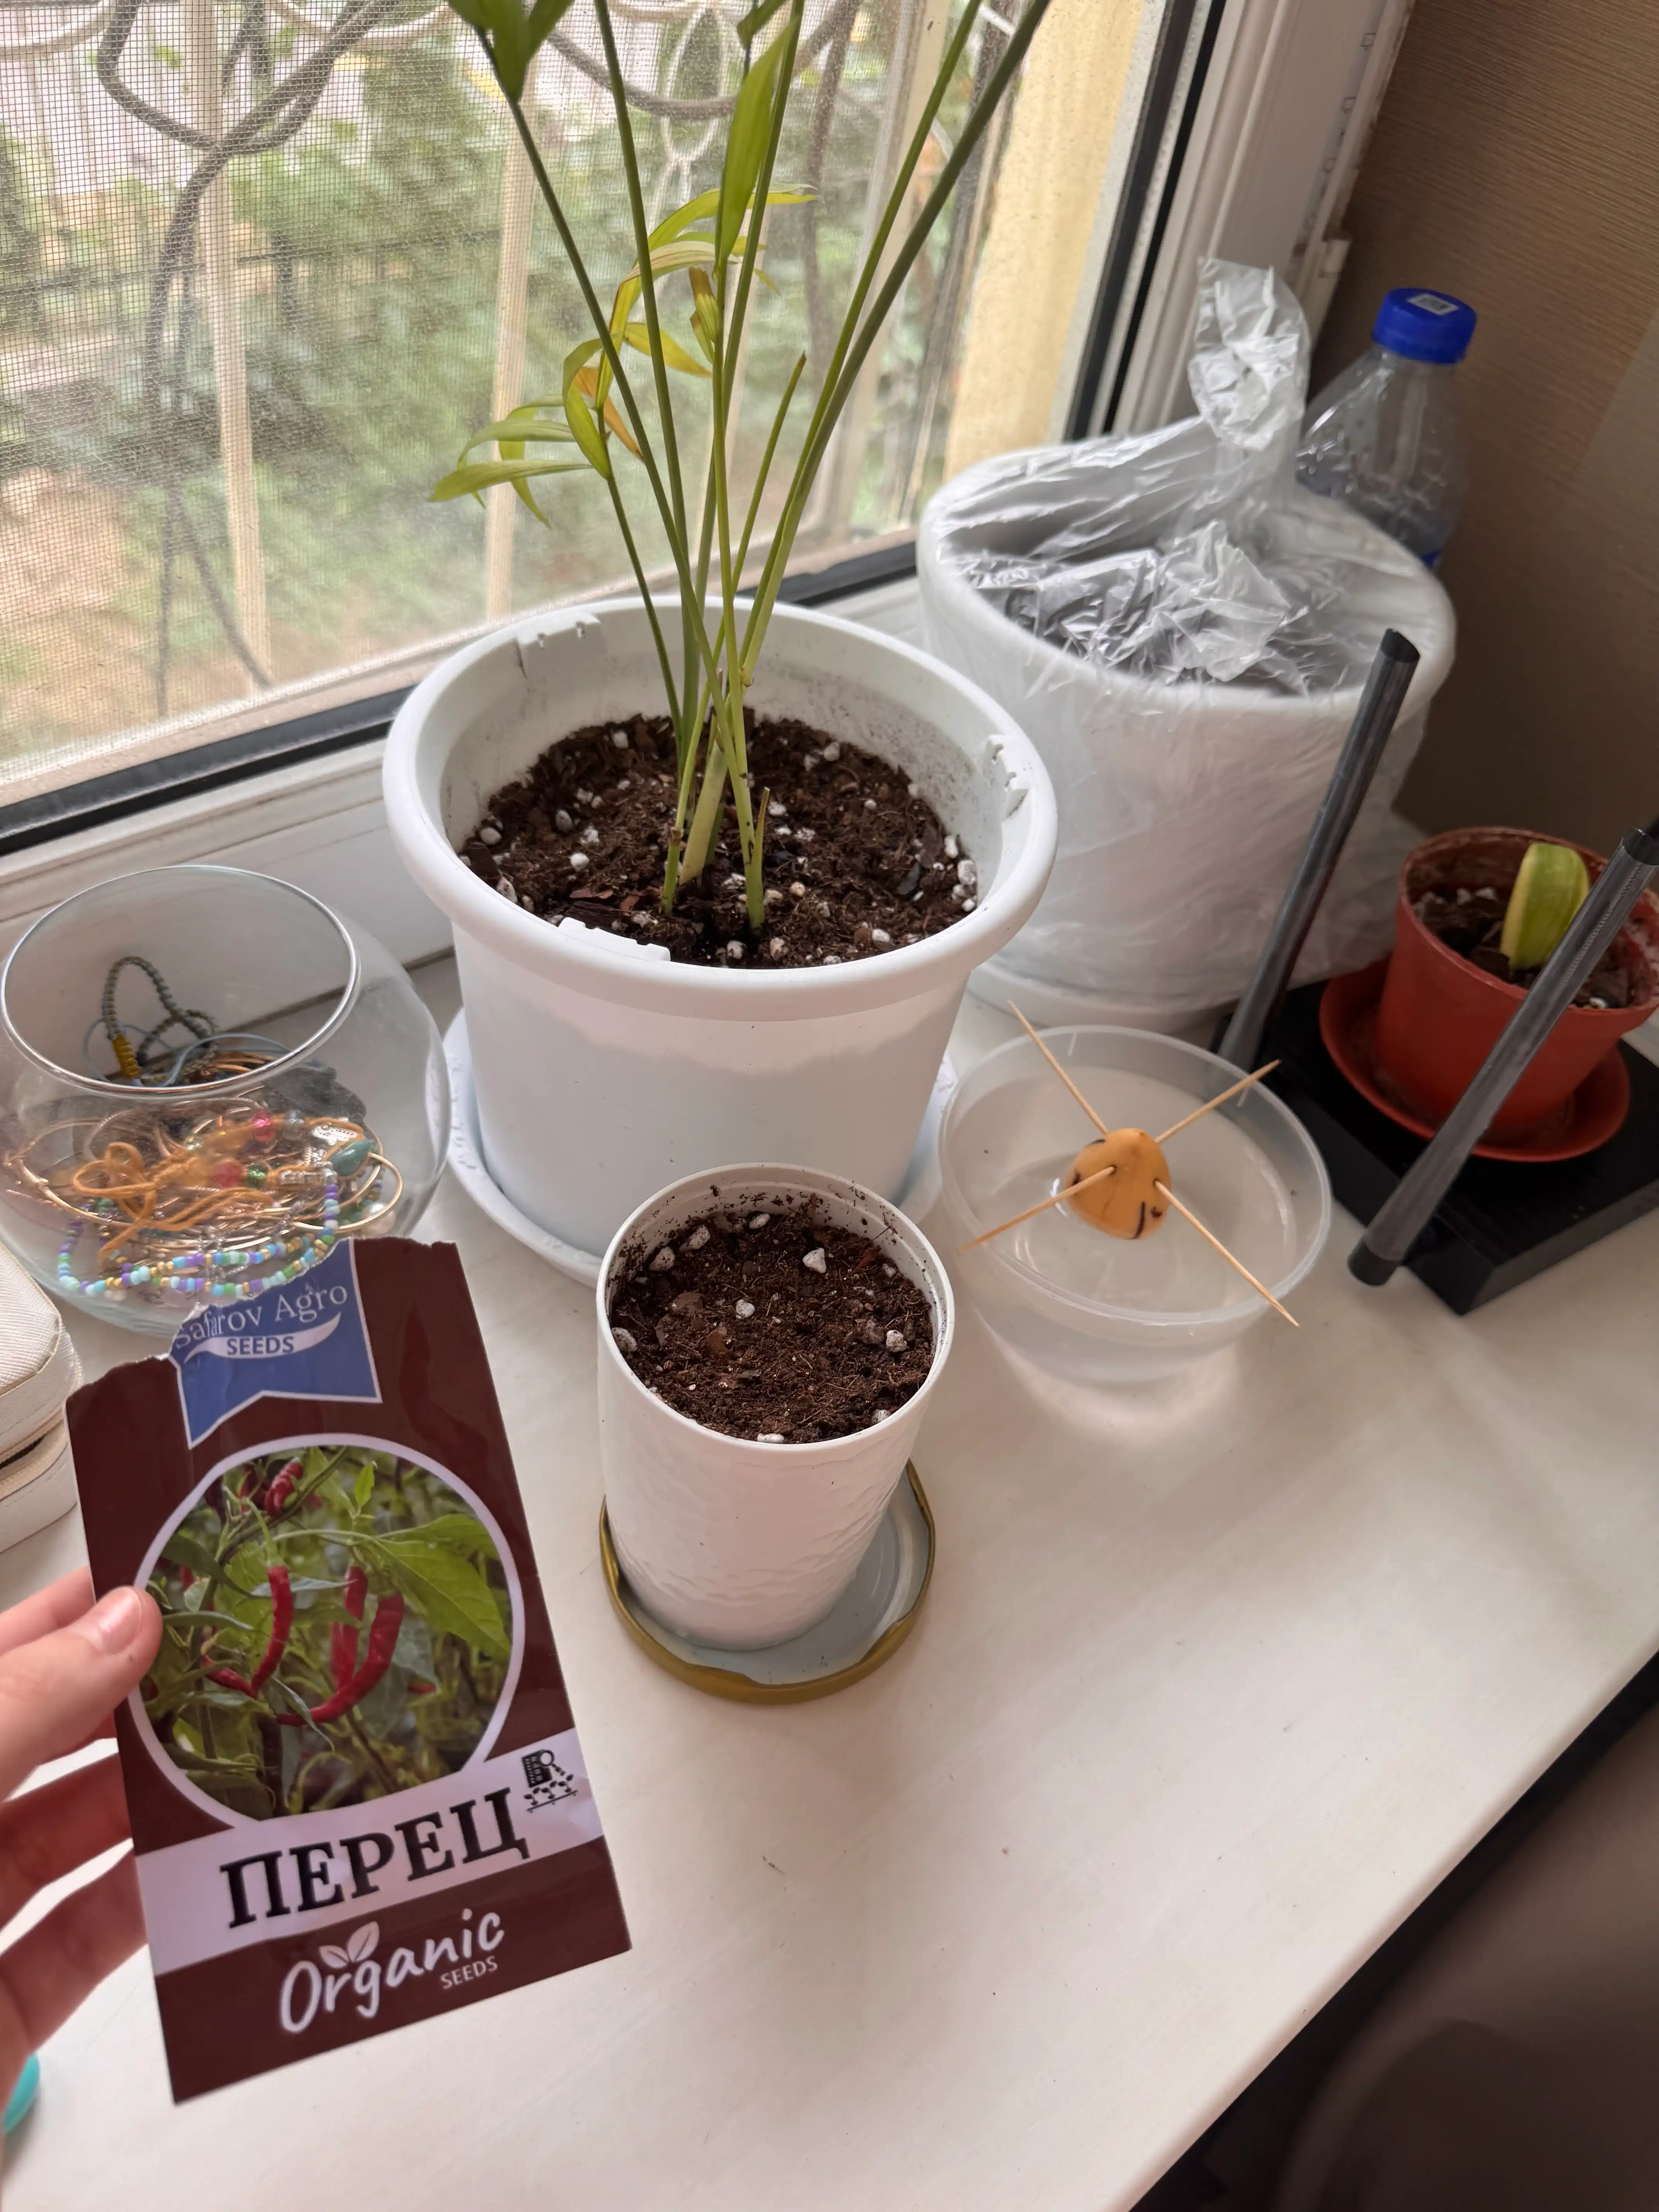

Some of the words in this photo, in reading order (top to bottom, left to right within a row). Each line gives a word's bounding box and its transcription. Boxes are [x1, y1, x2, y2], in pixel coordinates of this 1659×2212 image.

[275, 1285, 348, 1323] Agro
[227, 1336, 294, 1356] SEEDS
[220, 1787, 530, 1929] ПЕРЕЦ
[280, 1909, 505, 2033] Organic
[440, 1956, 498, 1989] SEEDS
